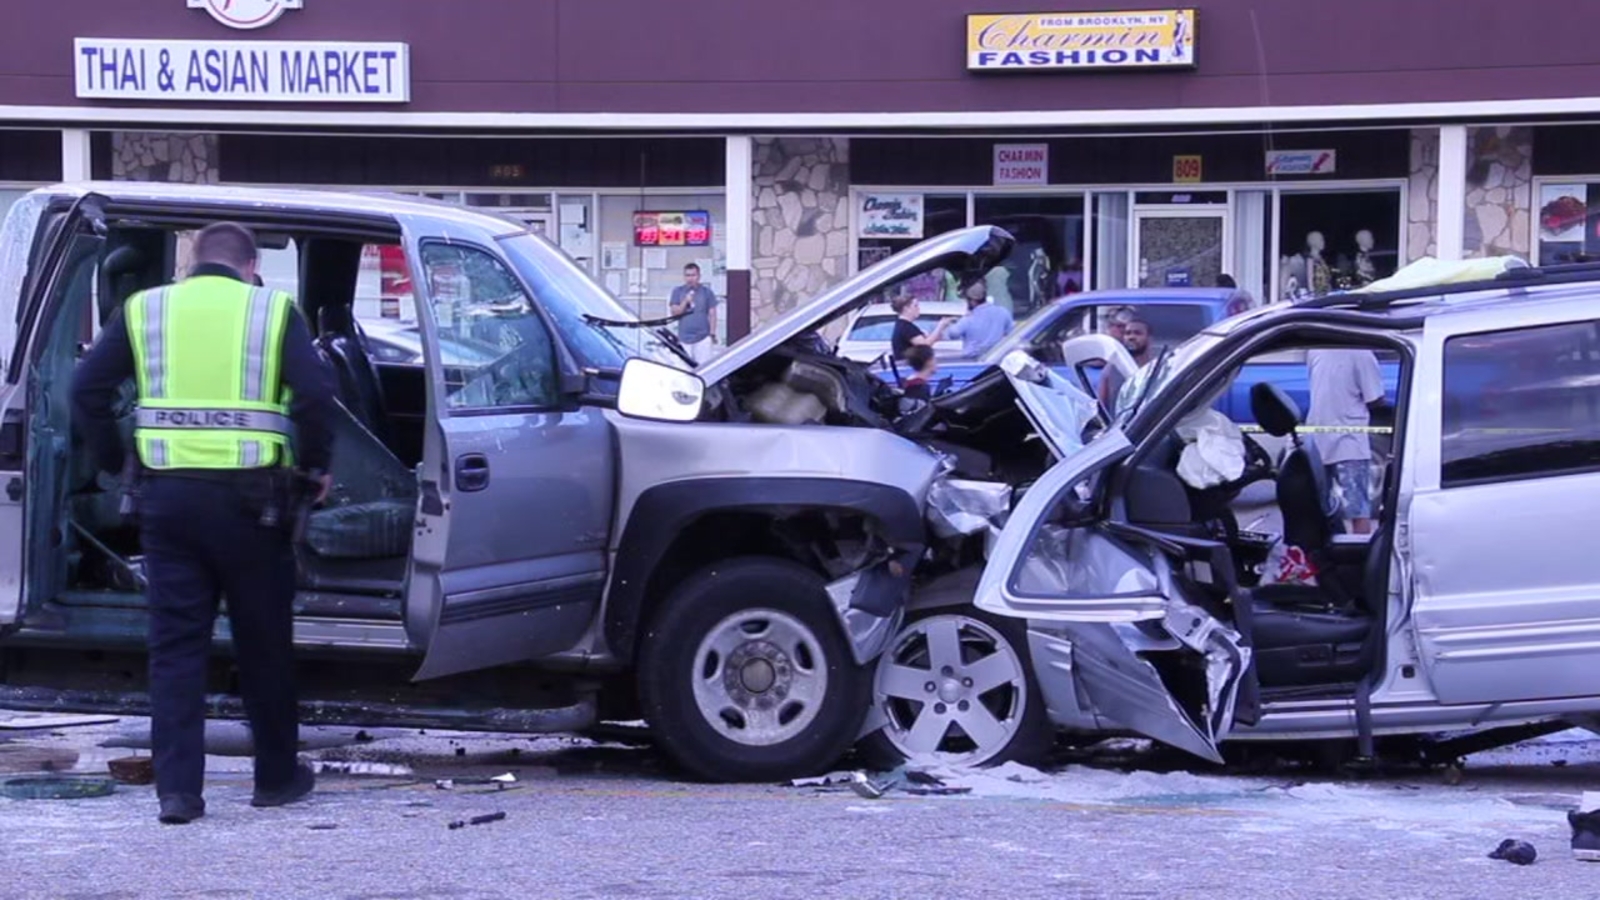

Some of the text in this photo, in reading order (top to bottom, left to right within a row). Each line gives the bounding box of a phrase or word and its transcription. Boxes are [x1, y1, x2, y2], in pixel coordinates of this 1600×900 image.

[1040, 18, 1073, 26] FROM
[1149, 15, 1165, 24] NY
[978, 18, 1160, 50] Charmin
[978, 49, 1161, 66] FASHION
[81, 47, 397, 94] THAI & ASIAN MARKET
[999, 150, 1044, 162] CHARMIN
[999, 167, 1042, 179] FASHION
[1176, 159, 1199, 178] 809
[154, 411, 251, 427] POLICE
